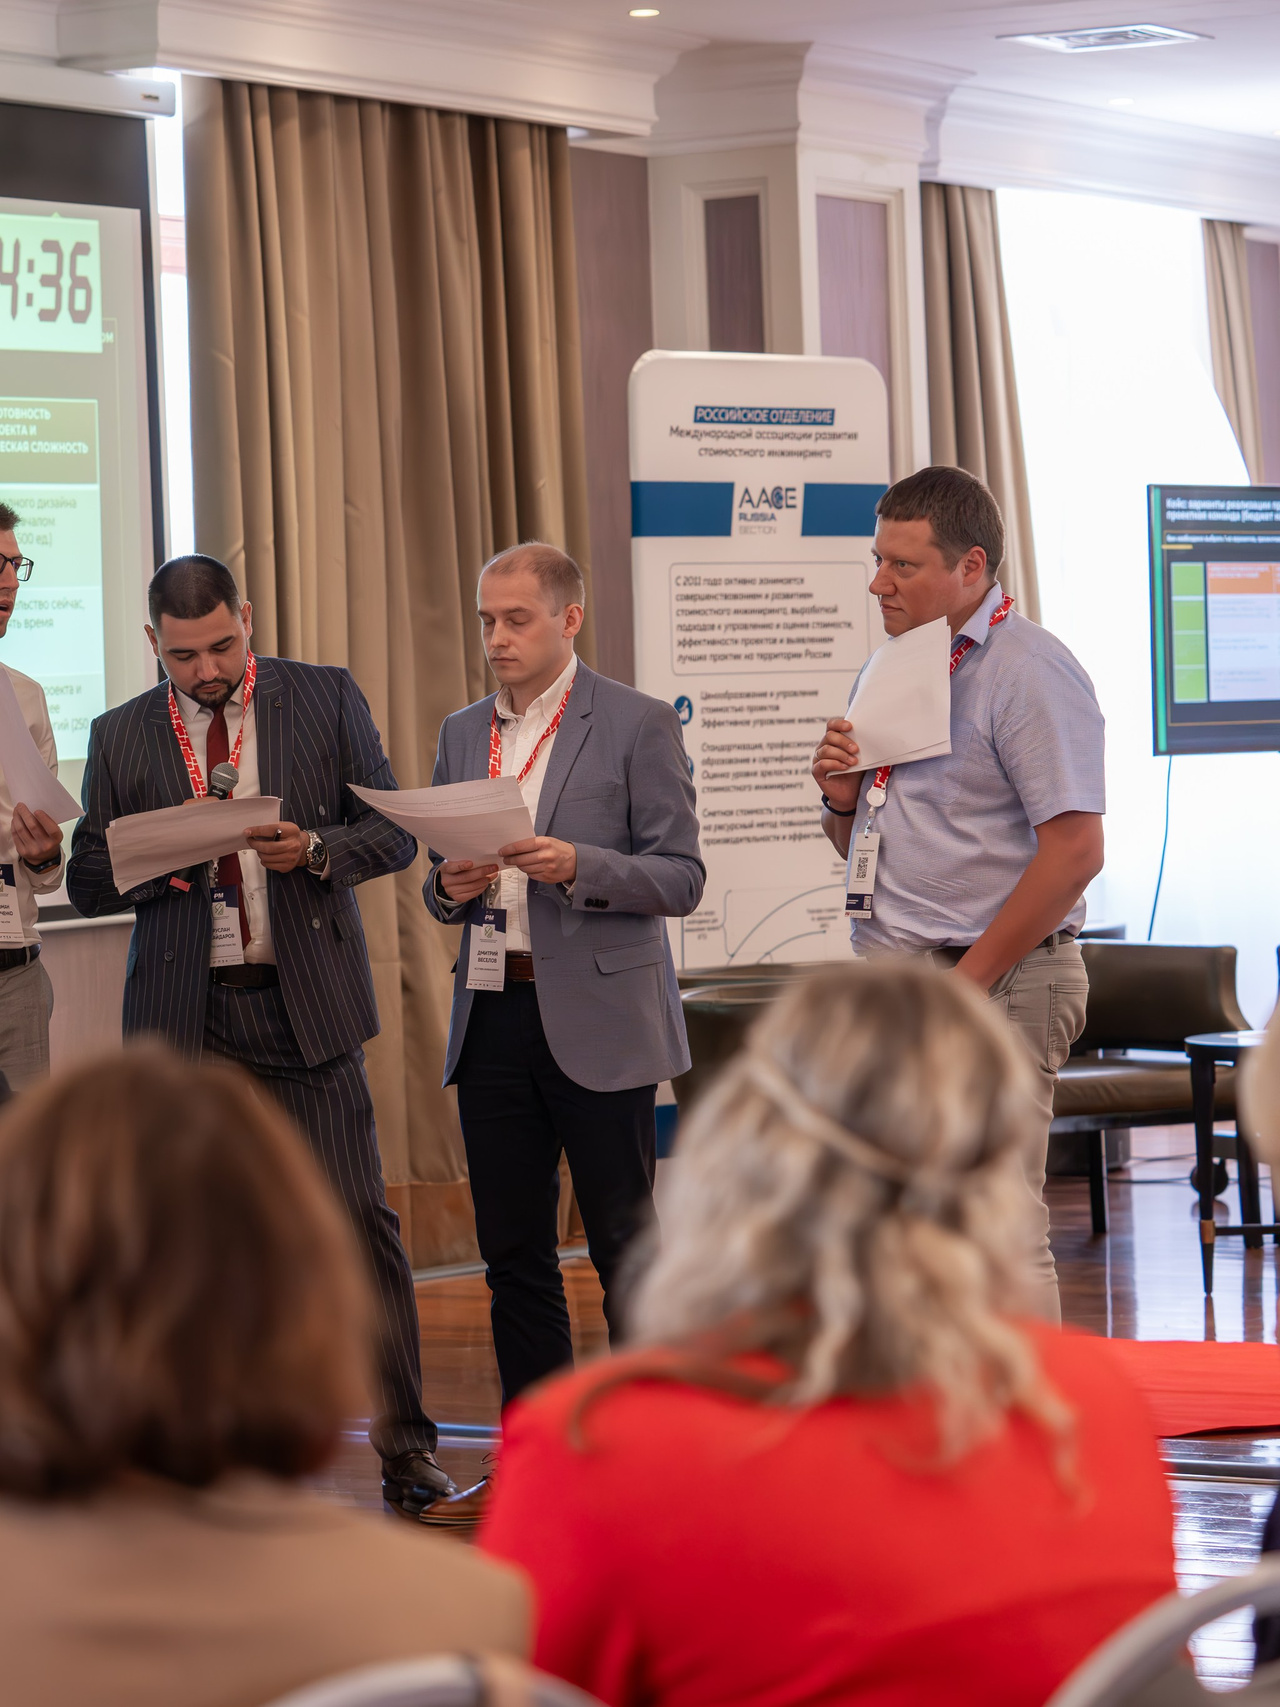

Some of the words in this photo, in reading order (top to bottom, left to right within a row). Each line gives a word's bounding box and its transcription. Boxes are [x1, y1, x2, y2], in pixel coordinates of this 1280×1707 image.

[695, 407, 768, 424] РОССИЙСКОЕ
[770, 408, 833, 425] ОТДЕЛЕНИЕ
[30, 425, 37, 436] И
[670, 425, 753, 441] Международной
[755, 430, 812, 441] ассоциации
[814, 430, 858, 442] развития
[31, 441, 89, 454] СЛОЖНОСТЬ
[698, 447, 765, 458] стоимостного
[767, 448, 832, 460] инжиниринга
[738, 512, 777, 522] RUSSIA
[738, 525, 777, 535] SECTION
[23, 618, 54, 631] время
[212, 932, 235, 941] АЙДАРОВ
